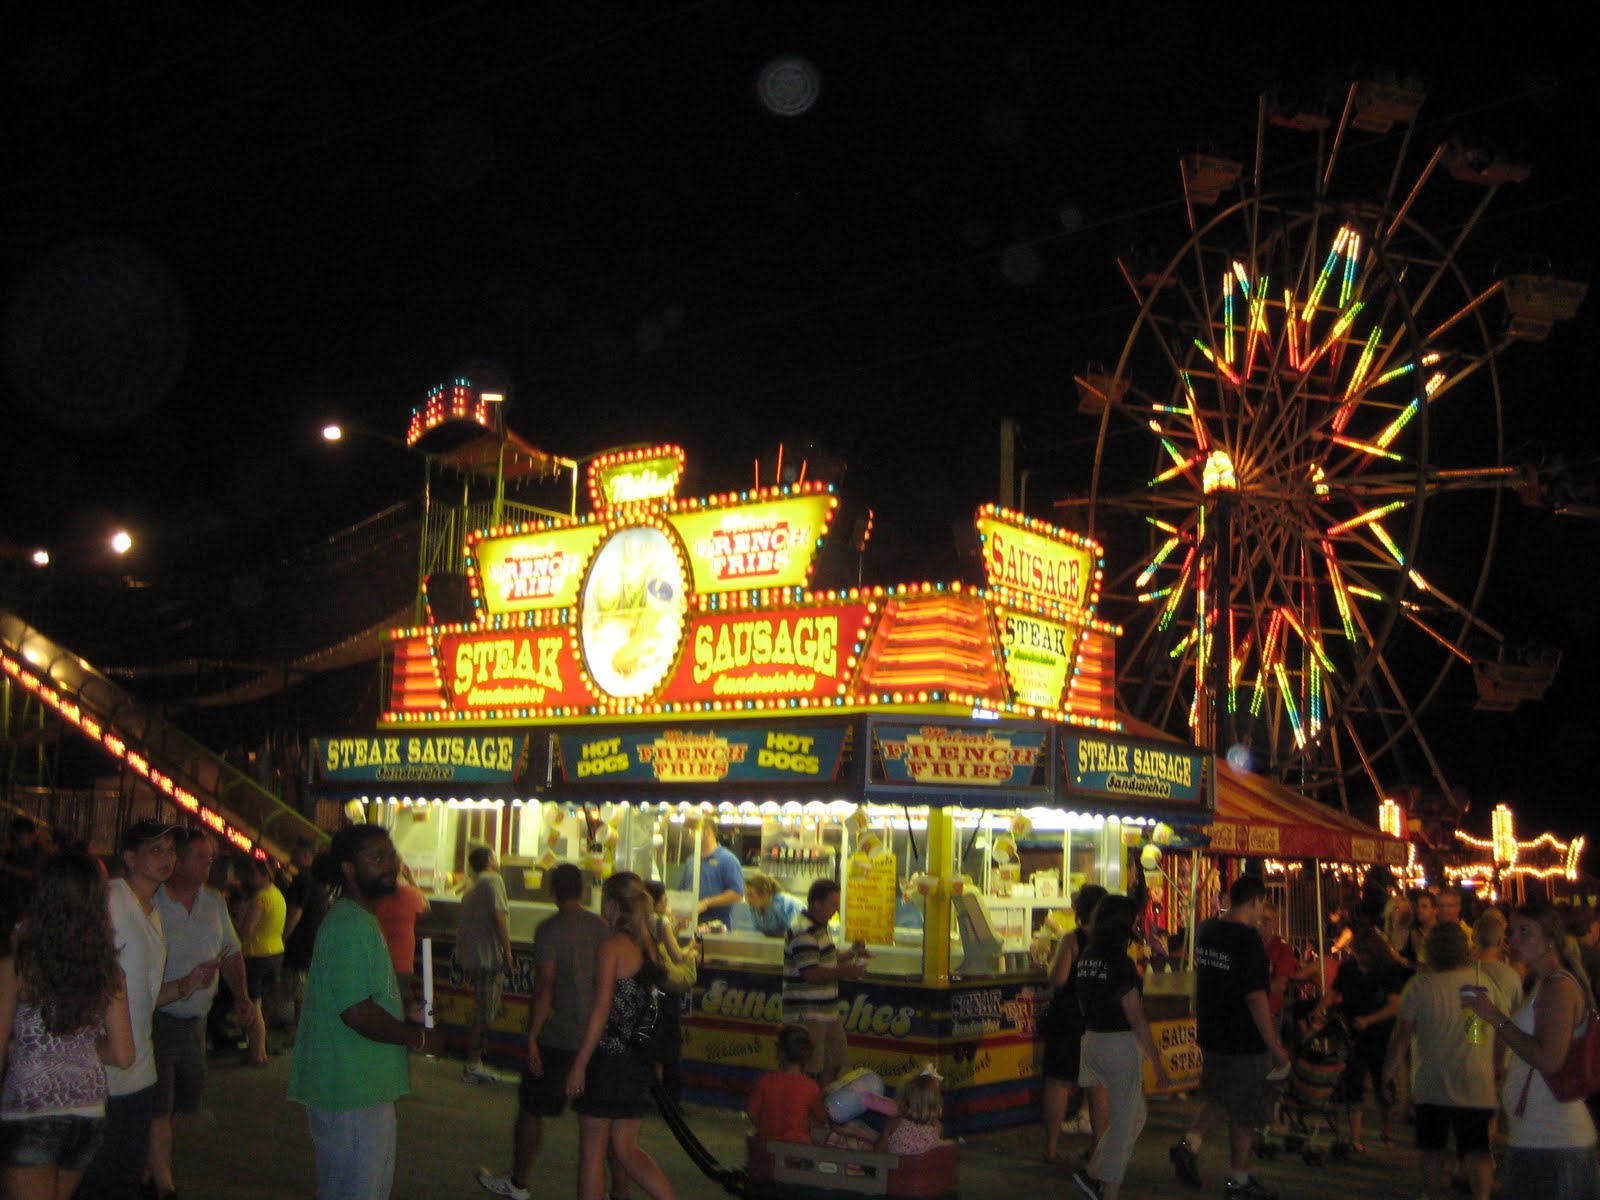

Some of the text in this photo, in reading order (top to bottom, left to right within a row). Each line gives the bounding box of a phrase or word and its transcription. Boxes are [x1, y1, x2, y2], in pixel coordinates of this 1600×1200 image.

[992, 531, 1080, 603] SAUSAGE
[693, 615, 838, 684] SAUSAGE
[1006, 616, 1067, 658] STEAK
[454, 636, 563, 696] STEAK
[326, 737, 514, 771] STEAK SAUSAGE
[581, 737, 622, 760] HOT
[637, 743, 748, 763] FRENCH
[766, 731, 815, 754] HOT
[880, 740, 1039, 765] FRENCH
[577, 753, 629, 778] DOGS
[653, 761, 729, 778] FRIES
[758, 748, 819, 774] DOGS
[904, 757, 1013, 780] FRIES
[1078, 739, 1192, 787] STEAK SAUSAGE
[1106, 772, 1171, 798] Sandwiches
[1161, 1024, 1197, 1050] SAUS
